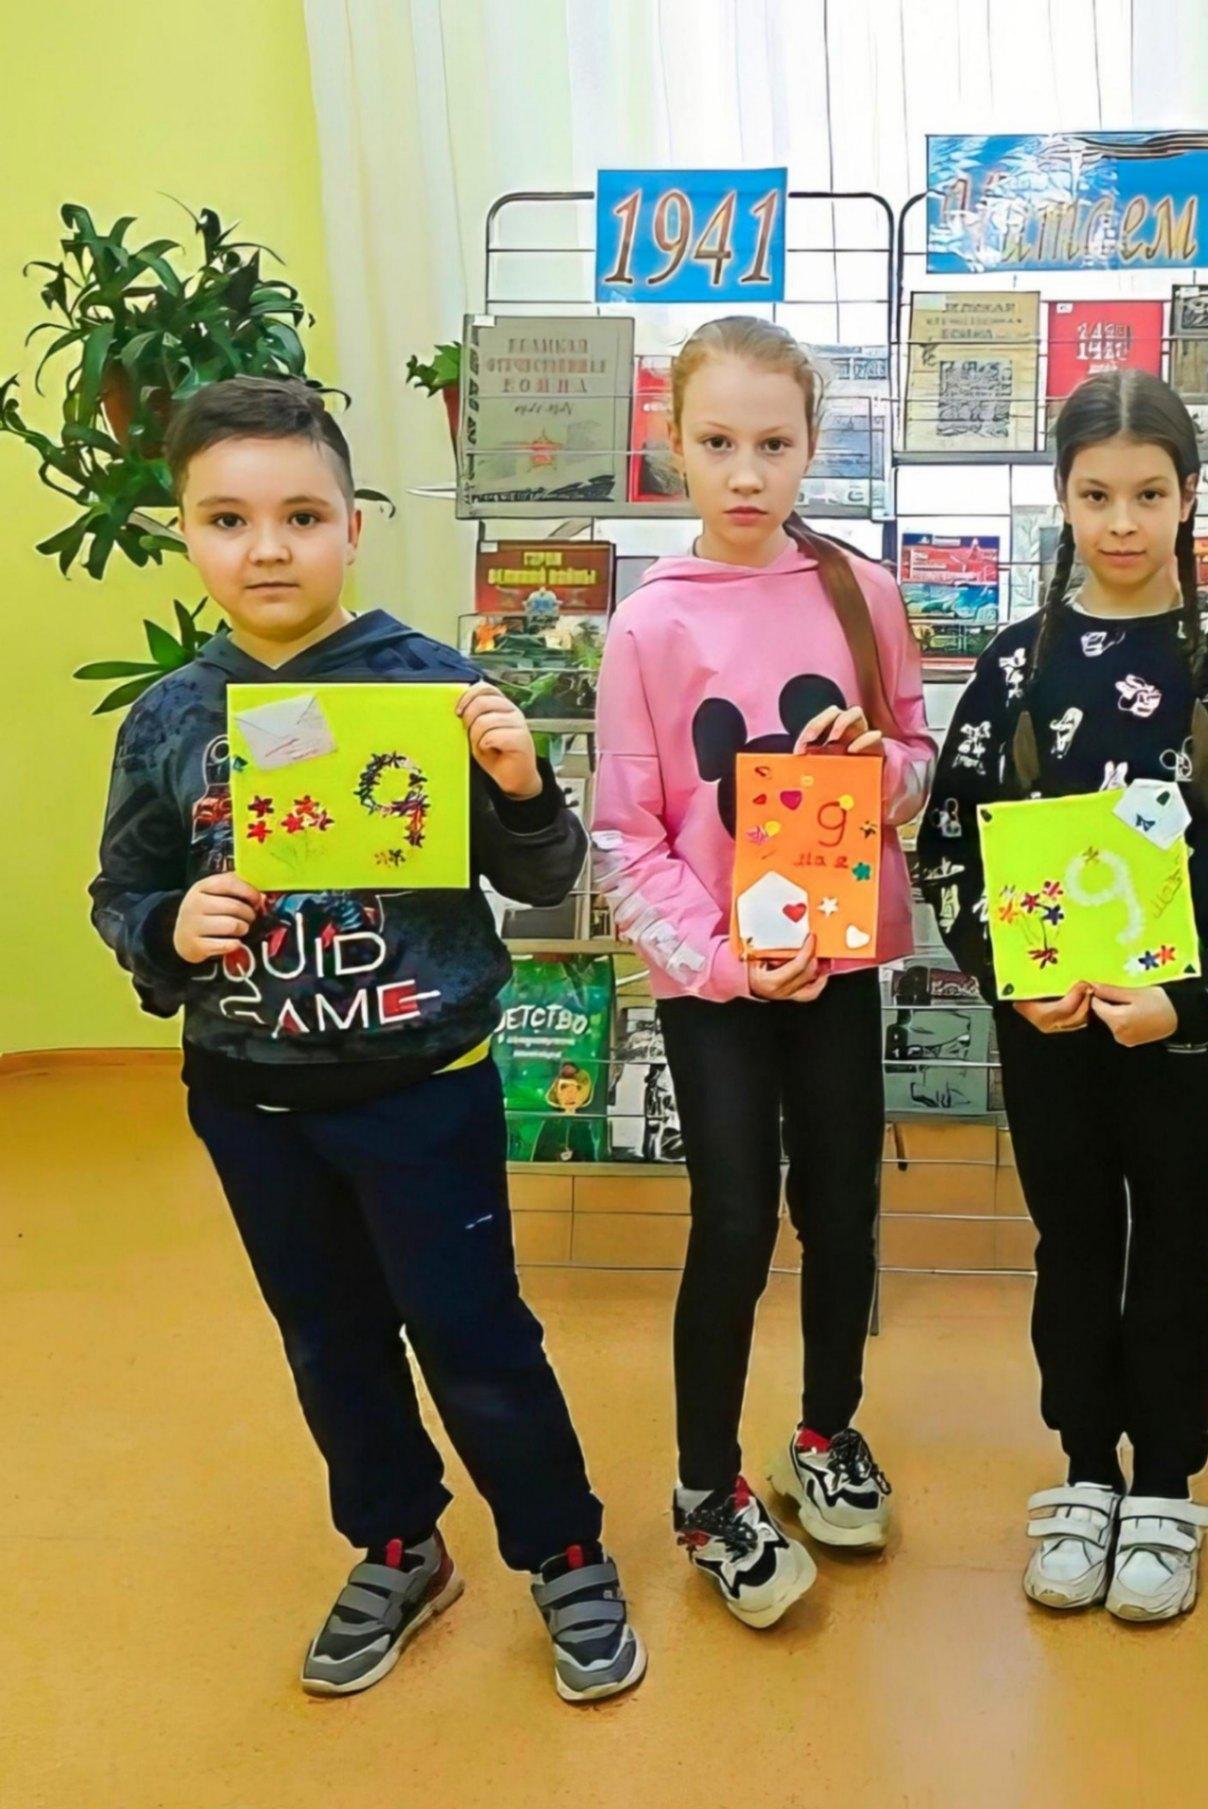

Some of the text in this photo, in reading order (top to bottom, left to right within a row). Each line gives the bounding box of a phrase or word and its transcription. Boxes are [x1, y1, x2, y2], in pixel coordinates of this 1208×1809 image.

[604, 189, 779, 286] 1941
[817, 800, 848, 847] 9
[1065, 848, 1146, 946] 9
